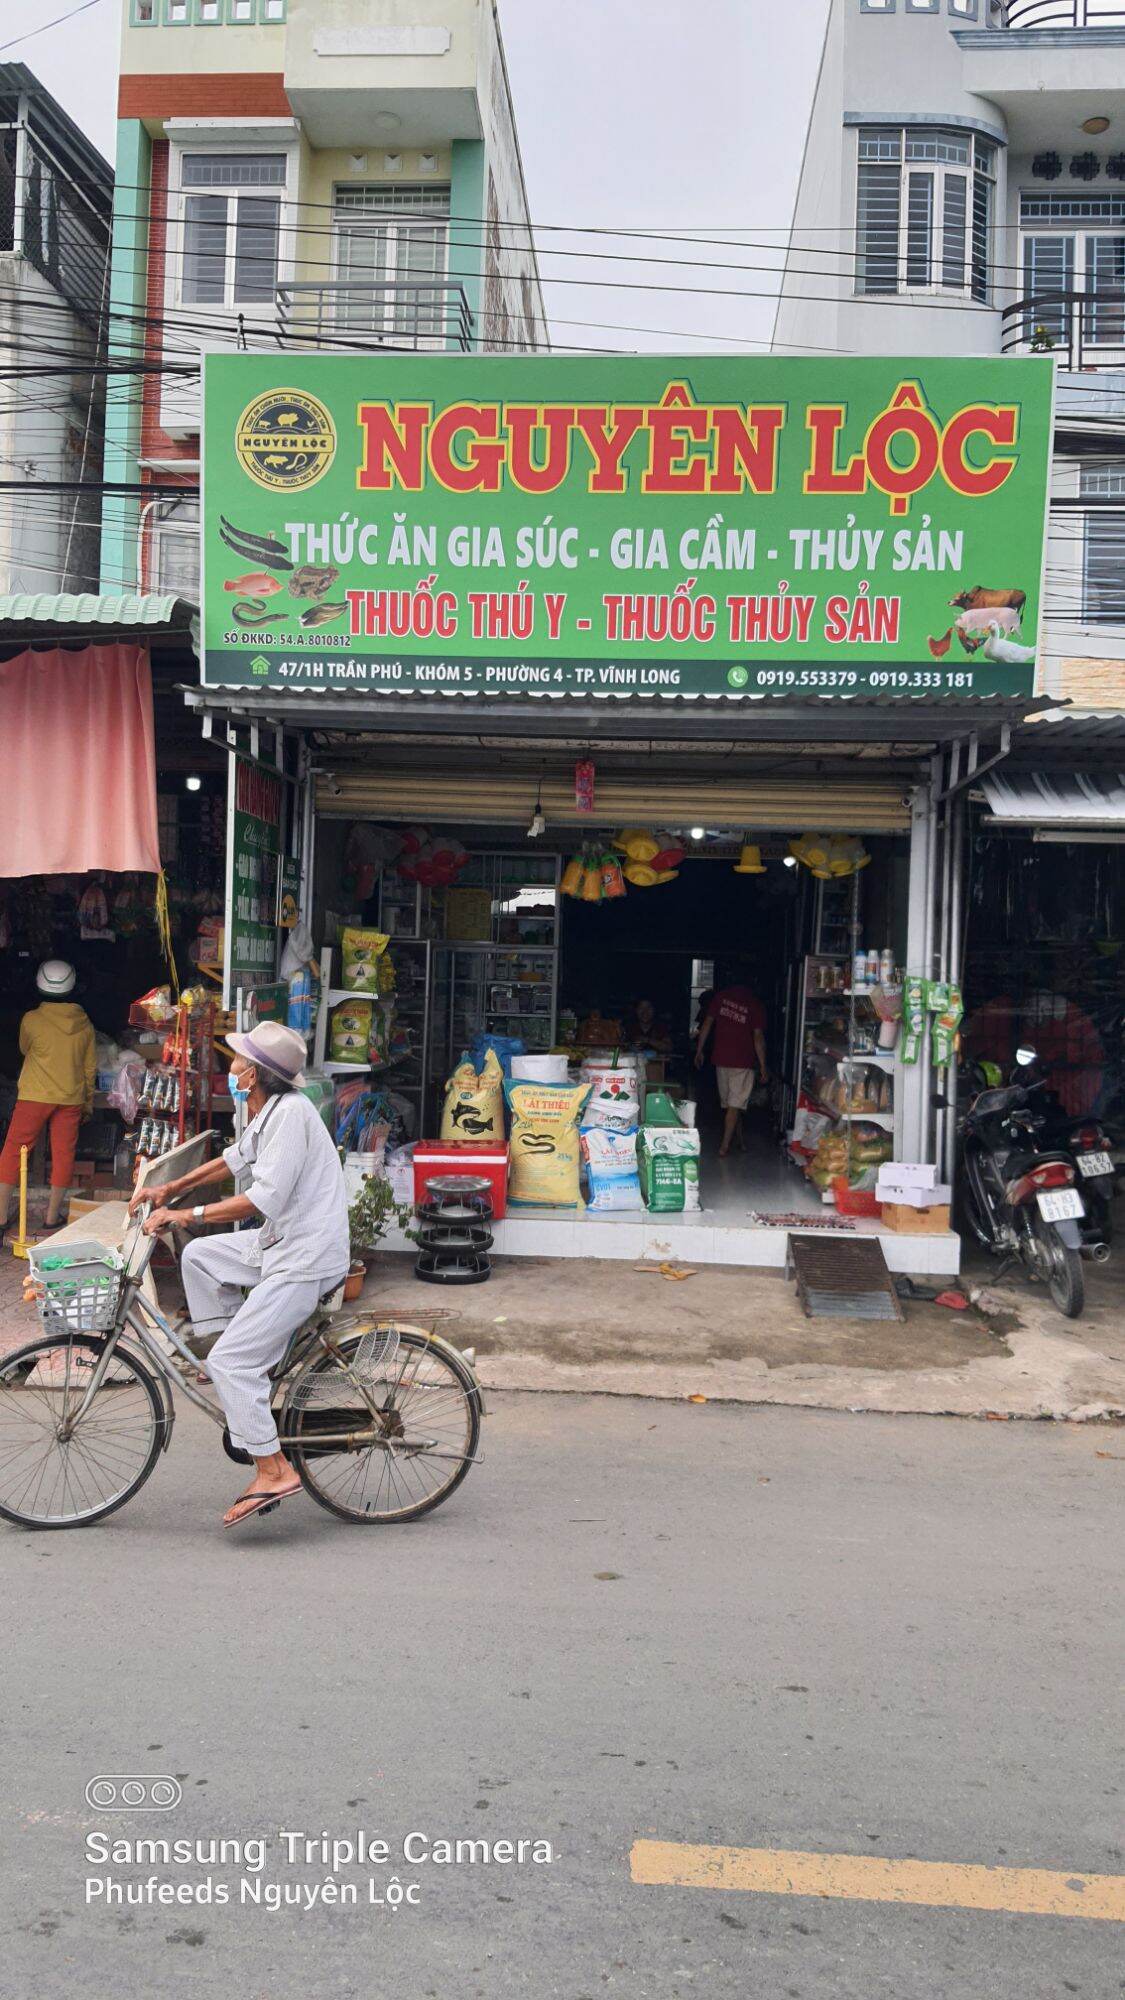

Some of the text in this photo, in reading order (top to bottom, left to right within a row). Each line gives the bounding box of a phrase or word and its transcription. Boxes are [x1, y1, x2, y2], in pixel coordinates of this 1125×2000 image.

[243, 437, 298, 448] NGUYÊN
[357, 379, 1021, 516] NGUYÊN LỘC
[285, 512, 378, 566] THỨC
[387, 512, 437, 567] ĂN
[447, 526, 506, 568] GIA
[516, 516, 579, 569] SÚC
[610, 528, 669, 570] GIA
[679, 513, 756, 571] CẦM
[790, 514, 884, 571] THỦY
[892, 514, 964, 571] SẢN
[345, 573, 457, 638] THUỐC
[468, 580, 536, 640] THÚ
[543, 593, 568, 640] Y
[603, 577, 715, 642] THUỐC
[726, 581, 816, 643] THỦY
[823, 581, 902, 644] SẢN
[223, 627, 351, 648] SỐ ĐKKD: 54.A.8010812
[278, 662, 324, 679] 47/1H
[326, 658, 368, 680] TRẦN
[370, 661, 403, 680] PHÚ
[415, 663, 462, 680] KHÓM
[463, 666, 473, 681] 5
[485, 664, 551, 682] PHƯỜNG
[553, 667, 563, 683] 4
[575, 667, 597, 684] TP.
[598, 665, 637, 684] VĨNH
[641, 668, 681, 685] LONG
[756, 670, 858, 687] 0919.553379
[868, 671, 943, 688] 0919.333
[945, 672, 974, 688] 181
